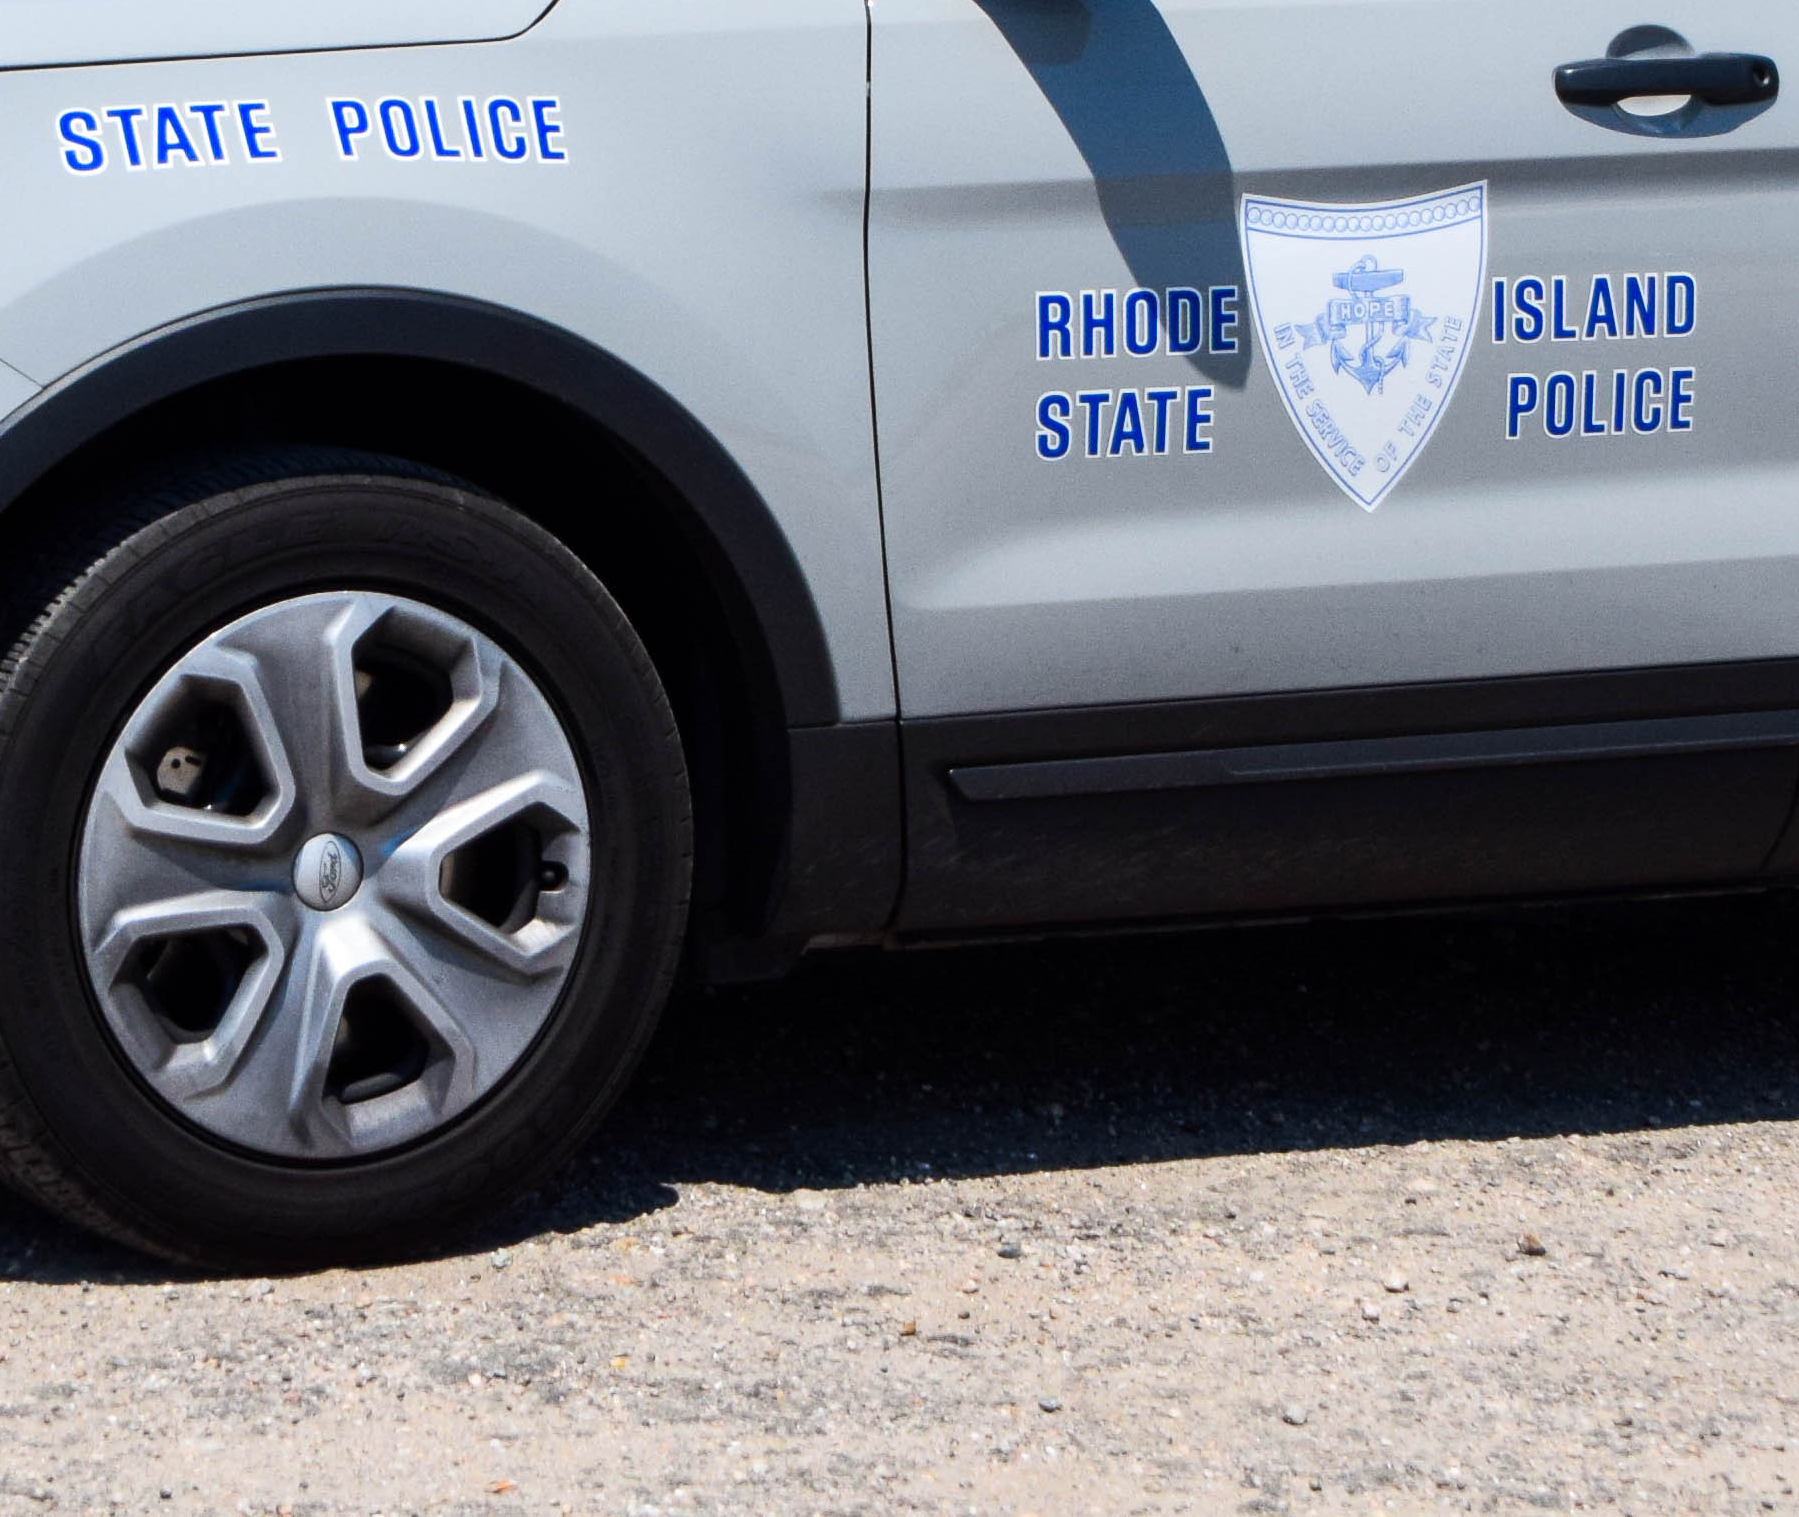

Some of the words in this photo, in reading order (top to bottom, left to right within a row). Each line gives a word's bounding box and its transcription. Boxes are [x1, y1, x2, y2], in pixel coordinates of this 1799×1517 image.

[57, 99, 283, 176] STATE
[325, 94, 569, 165] POLICE
[1035, 285, 1239, 360] RHODE
[1492, 273, 1698, 344] ISLAND
[1339, 299, 1397, 322] HOPE
[1035, 387, 1215, 461] STATE
[1504, 367, 1696, 440] POLICE
[1273, 322, 1295, 350] IN
[1285, 353, 1315, 400] THE
[1305, 398, 1366, 477] SERVICE
[1374, 441, 1398, 473] OF
[1398, 393, 1432, 437] THE
[1425, 314, 1463, 388] STATE
[320, 851, 338, 893] Ford
